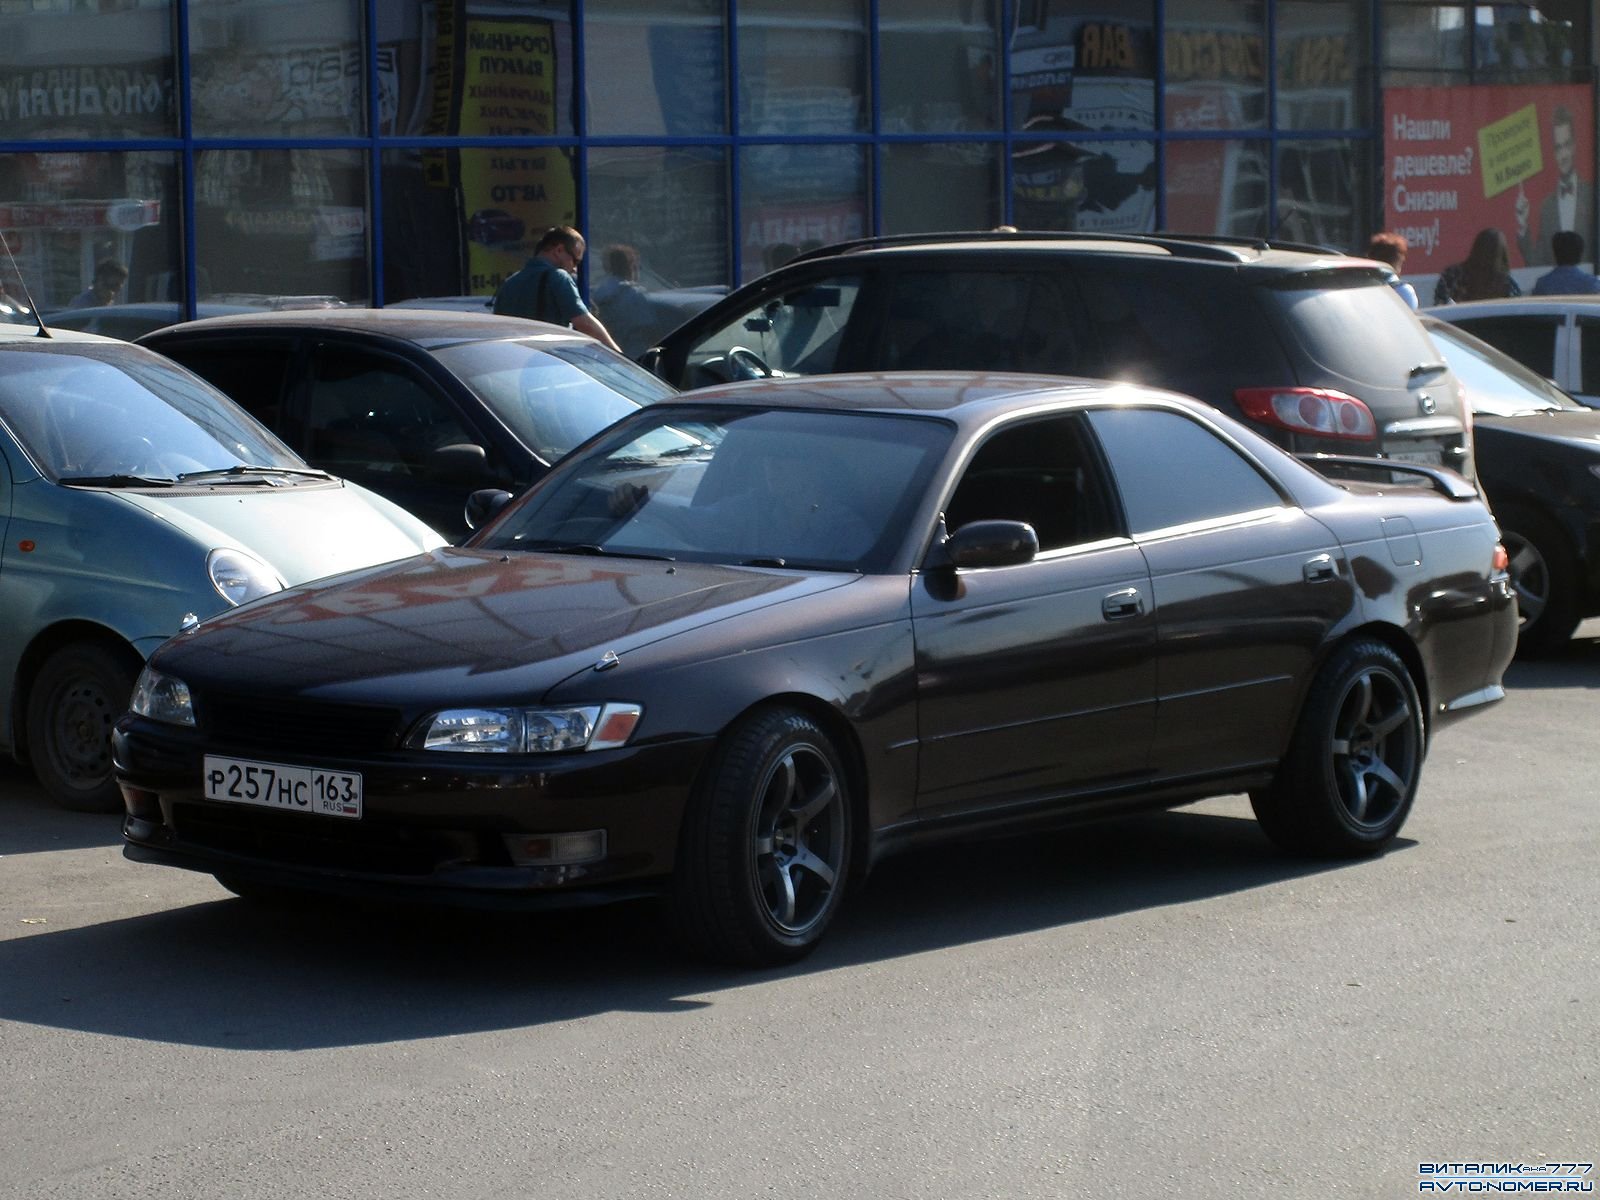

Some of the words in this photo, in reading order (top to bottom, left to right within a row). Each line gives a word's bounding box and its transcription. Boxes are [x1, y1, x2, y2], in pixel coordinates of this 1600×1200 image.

[1393, 114, 1450, 140] Нашли
[1393, 146, 1474, 180] дешевле?
[1393, 184, 1458, 212] Снизим
[314, 775, 353, 802] 163
[323, 801, 342, 812] RUS
